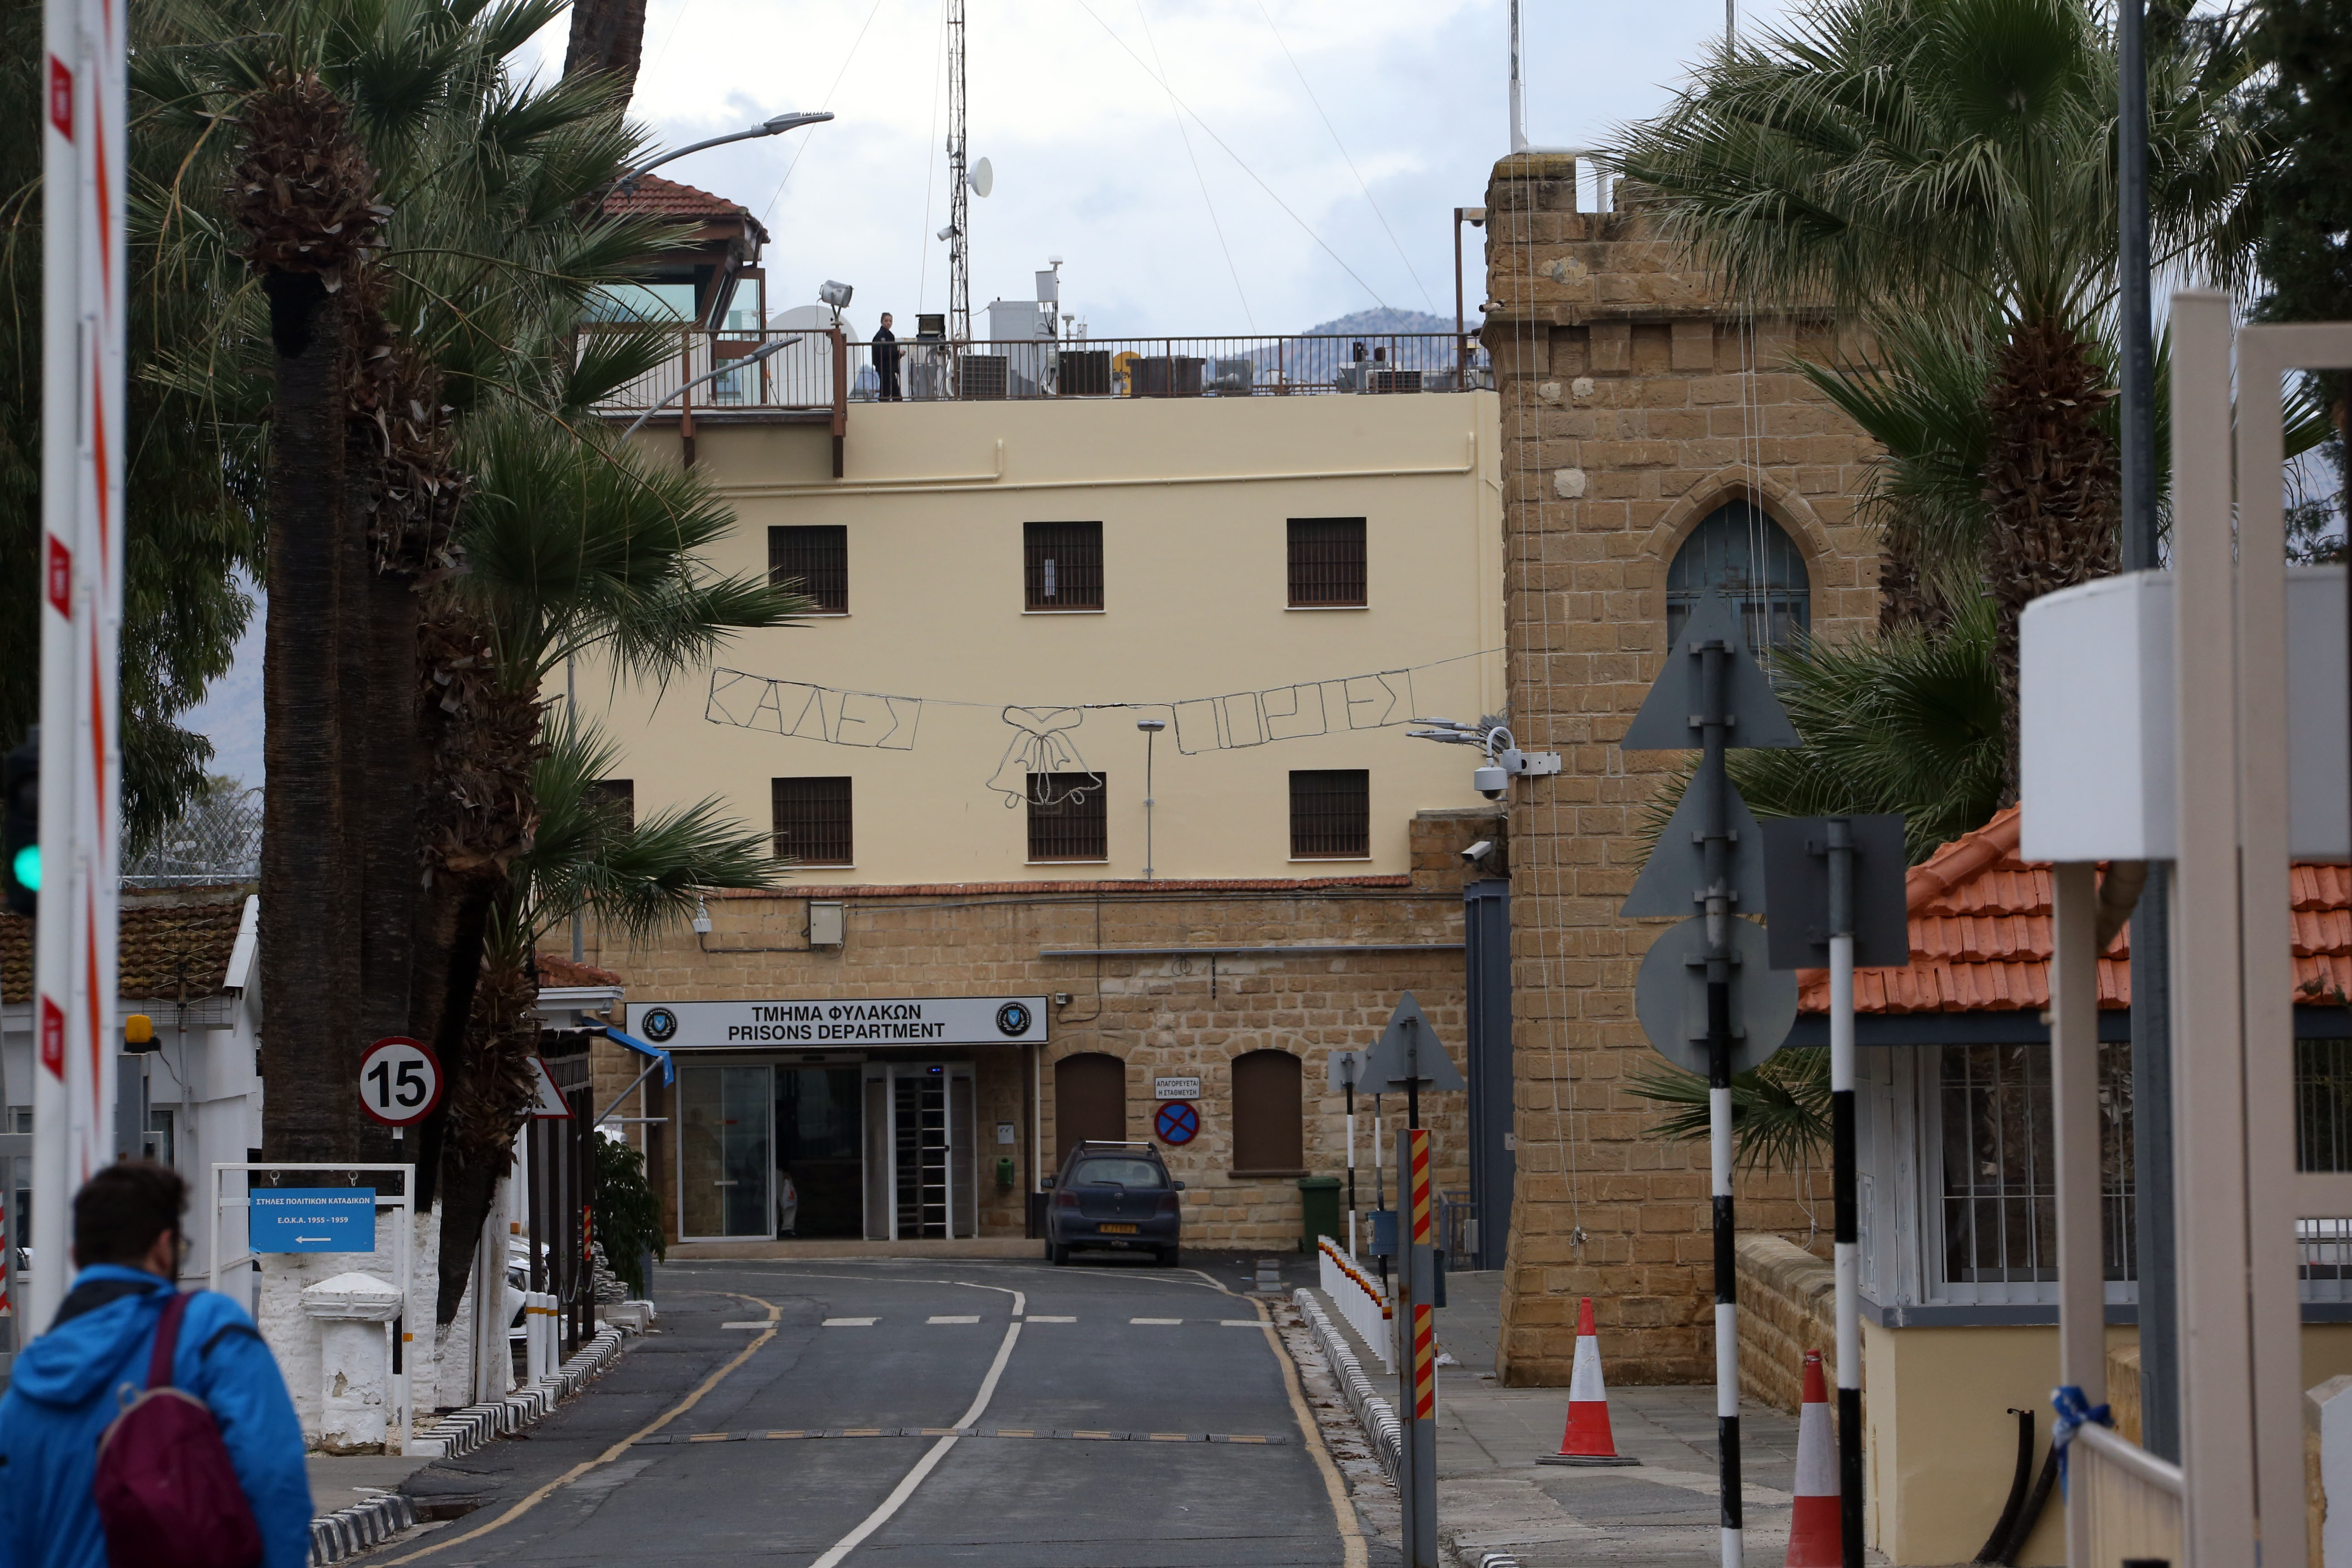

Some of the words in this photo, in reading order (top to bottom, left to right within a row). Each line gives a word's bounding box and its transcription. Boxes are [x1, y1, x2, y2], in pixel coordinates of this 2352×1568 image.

[705, 667, 921, 750] ΚΑΛΕΣ
[751, 1006, 823, 1022] ΤΜΗΜΑ
[828, 1004, 921, 1021] ΦΥΛΑΚΩΝ
[729, 1024, 812, 1041] PRISONS
[818, 1023, 946, 1040] DEPARTMENT
[368, 1060, 427, 1107] 15
